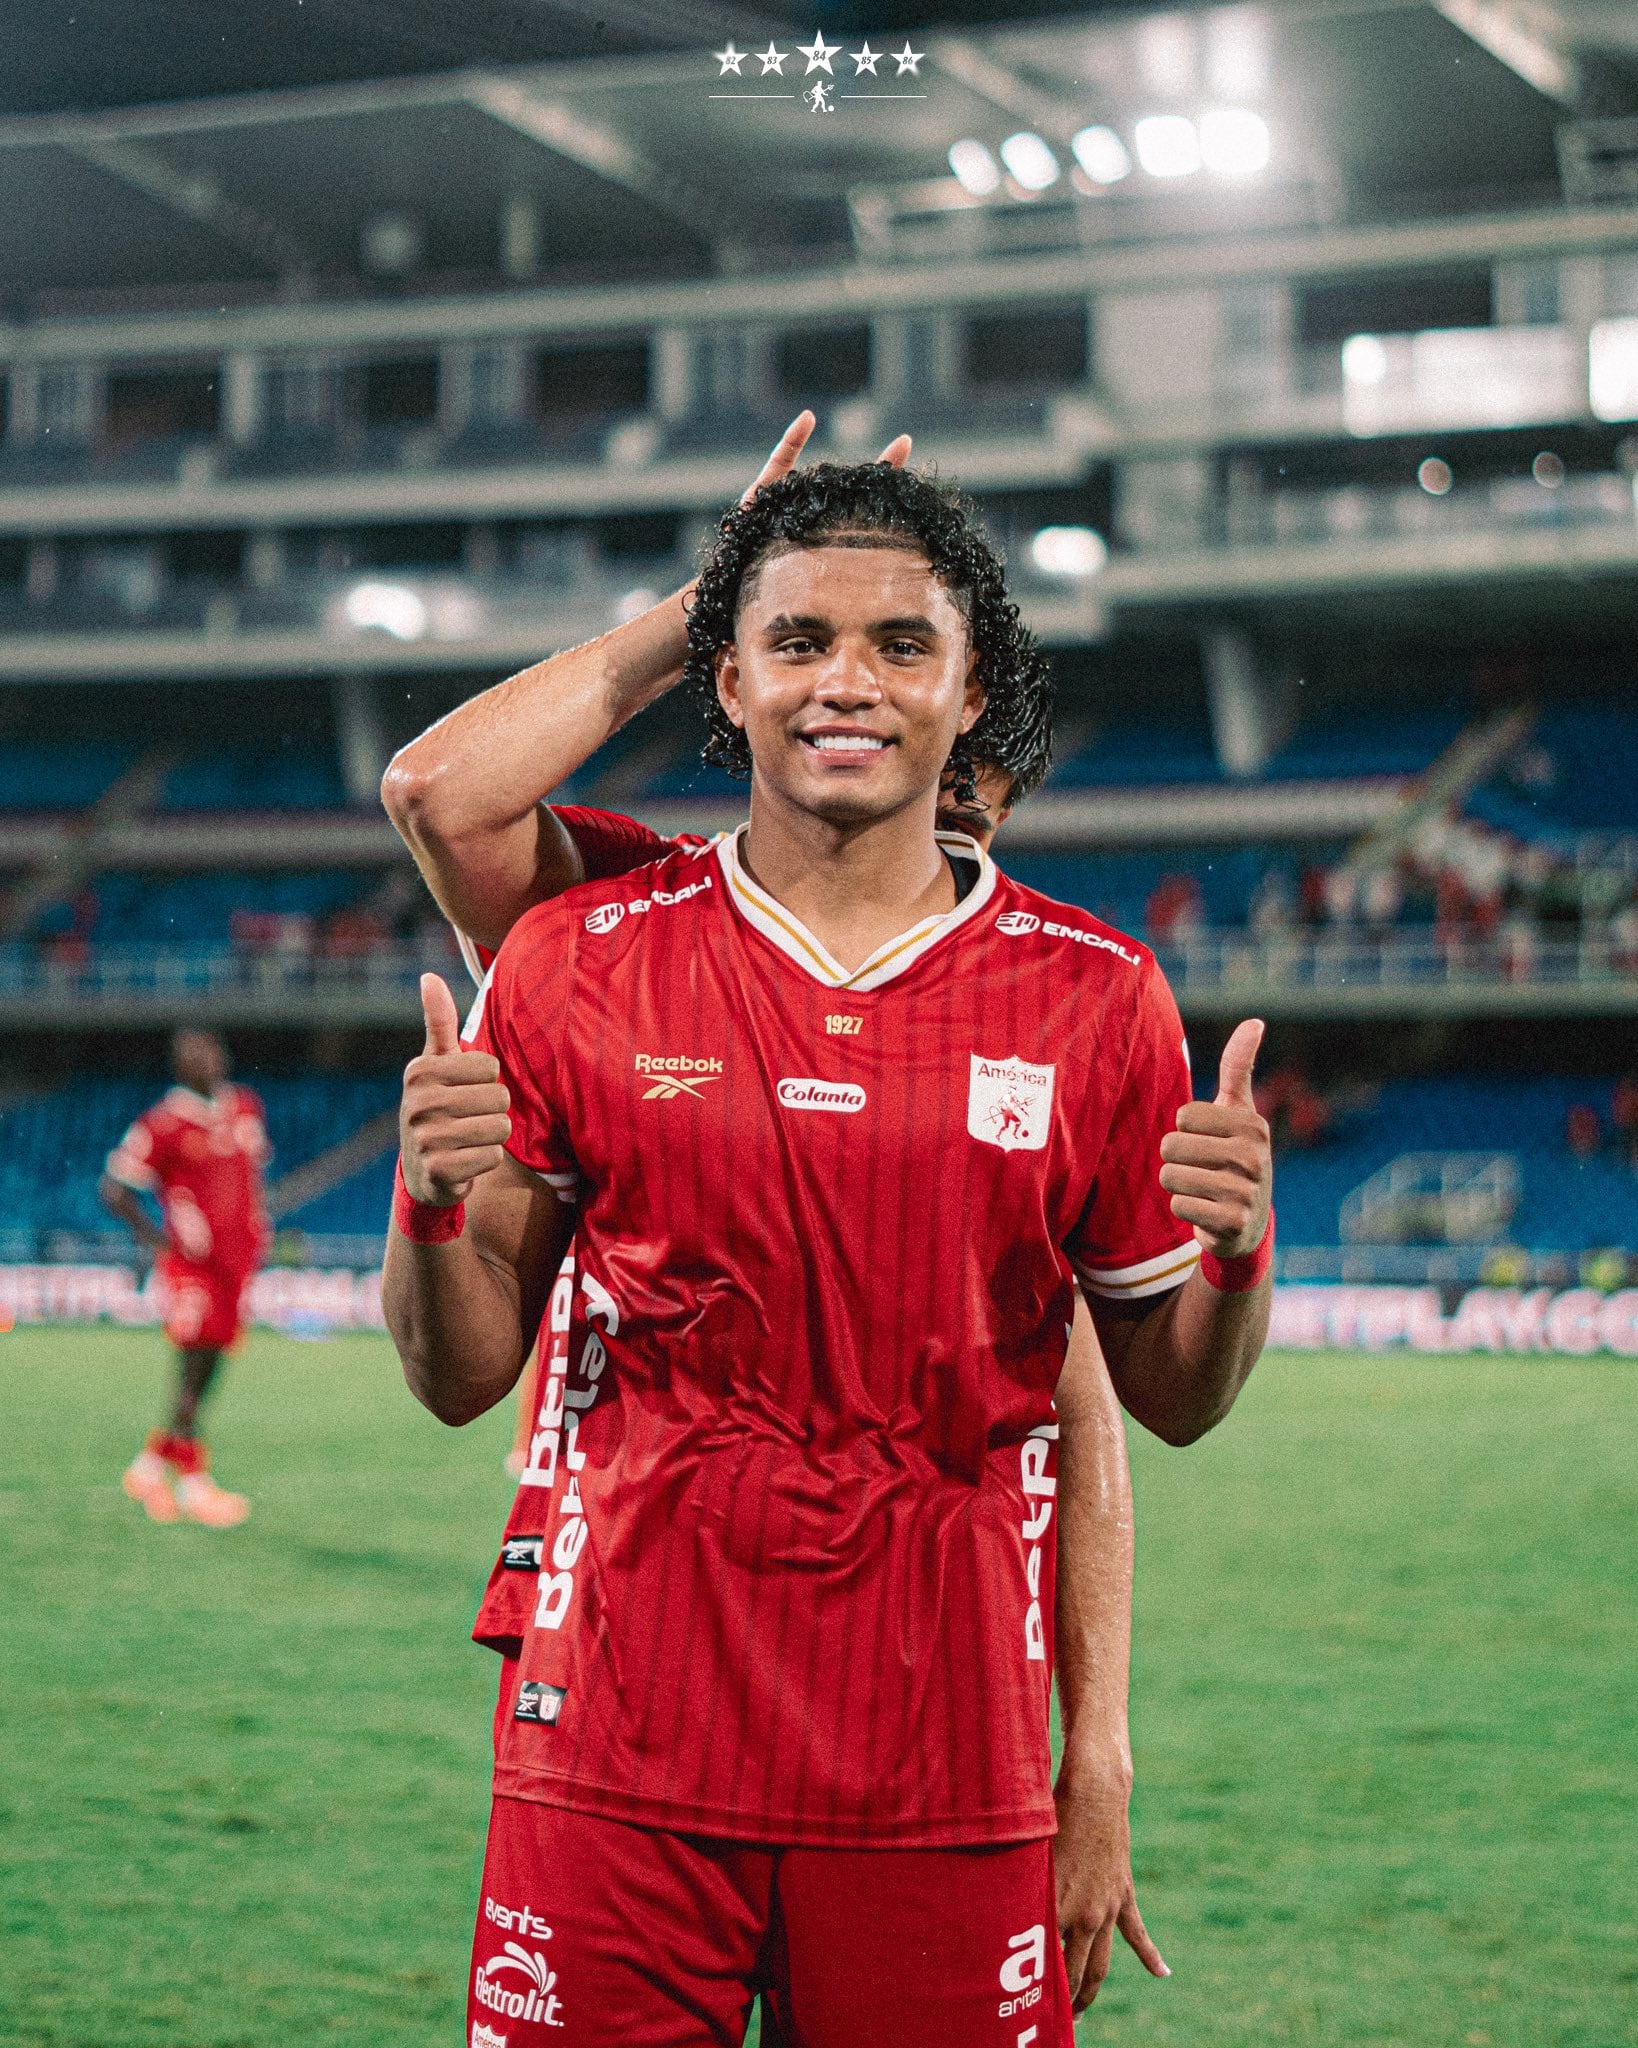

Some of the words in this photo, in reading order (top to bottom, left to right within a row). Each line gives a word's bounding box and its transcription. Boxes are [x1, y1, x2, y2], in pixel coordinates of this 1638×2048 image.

[1042, 921, 1141, 966] EMCALI
[824, 1014, 864, 1035] 1927
[635, 1053, 724, 1073] Reebok
[977, 1062, 1047, 1087] América
[779, 1083, 863, 1106] Colanta
[485, 1896, 553, 1940] events
